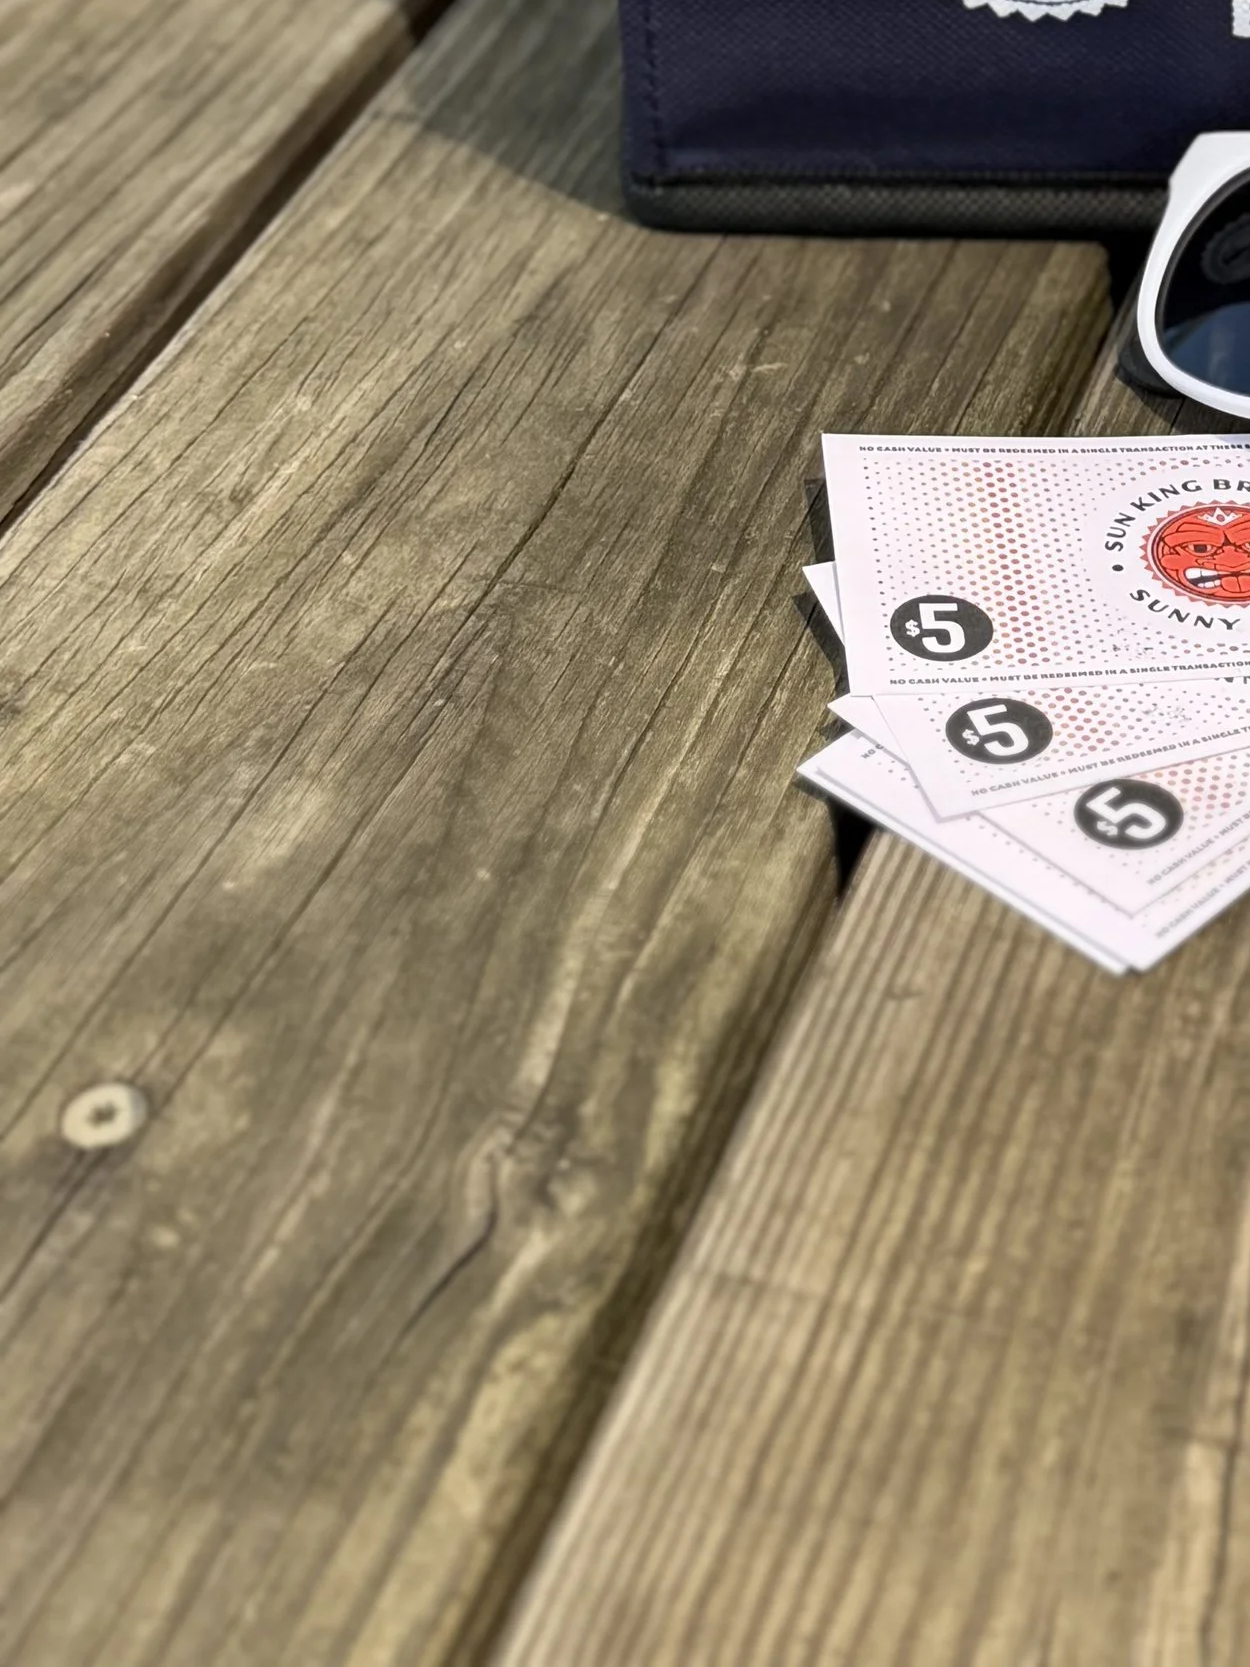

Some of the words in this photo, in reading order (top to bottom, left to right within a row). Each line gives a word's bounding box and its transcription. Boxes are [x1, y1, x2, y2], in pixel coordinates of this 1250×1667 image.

[1119, 445, 1193, 453] TRANSACTION
[1104, 512, 1136, 552] SUN
[1130, 479, 1203, 512] KING
[905, 602, 966, 654] $5
[1129, 589, 1242, 630] SUNNY
[908, 677, 939, 685] CASH
[941, 676, 979, 684] VALUE
[989, 674, 1021, 682] MUST
[1039, 669, 1103, 679] REDEEMED
[1129, 665, 1170, 674] SINGLE
[961, 704, 1029, 757] $5
[988, 778, 1020, 793] CASH
[1021, 770, 1058, 786] VALUE
[1067, 761, 1099, 775] MUST
[1115, 741, 1177, 763] REDEEMED
[1200, 728, 1240, 742] SINGLE
[1085, 786, 1167, 840] $5
